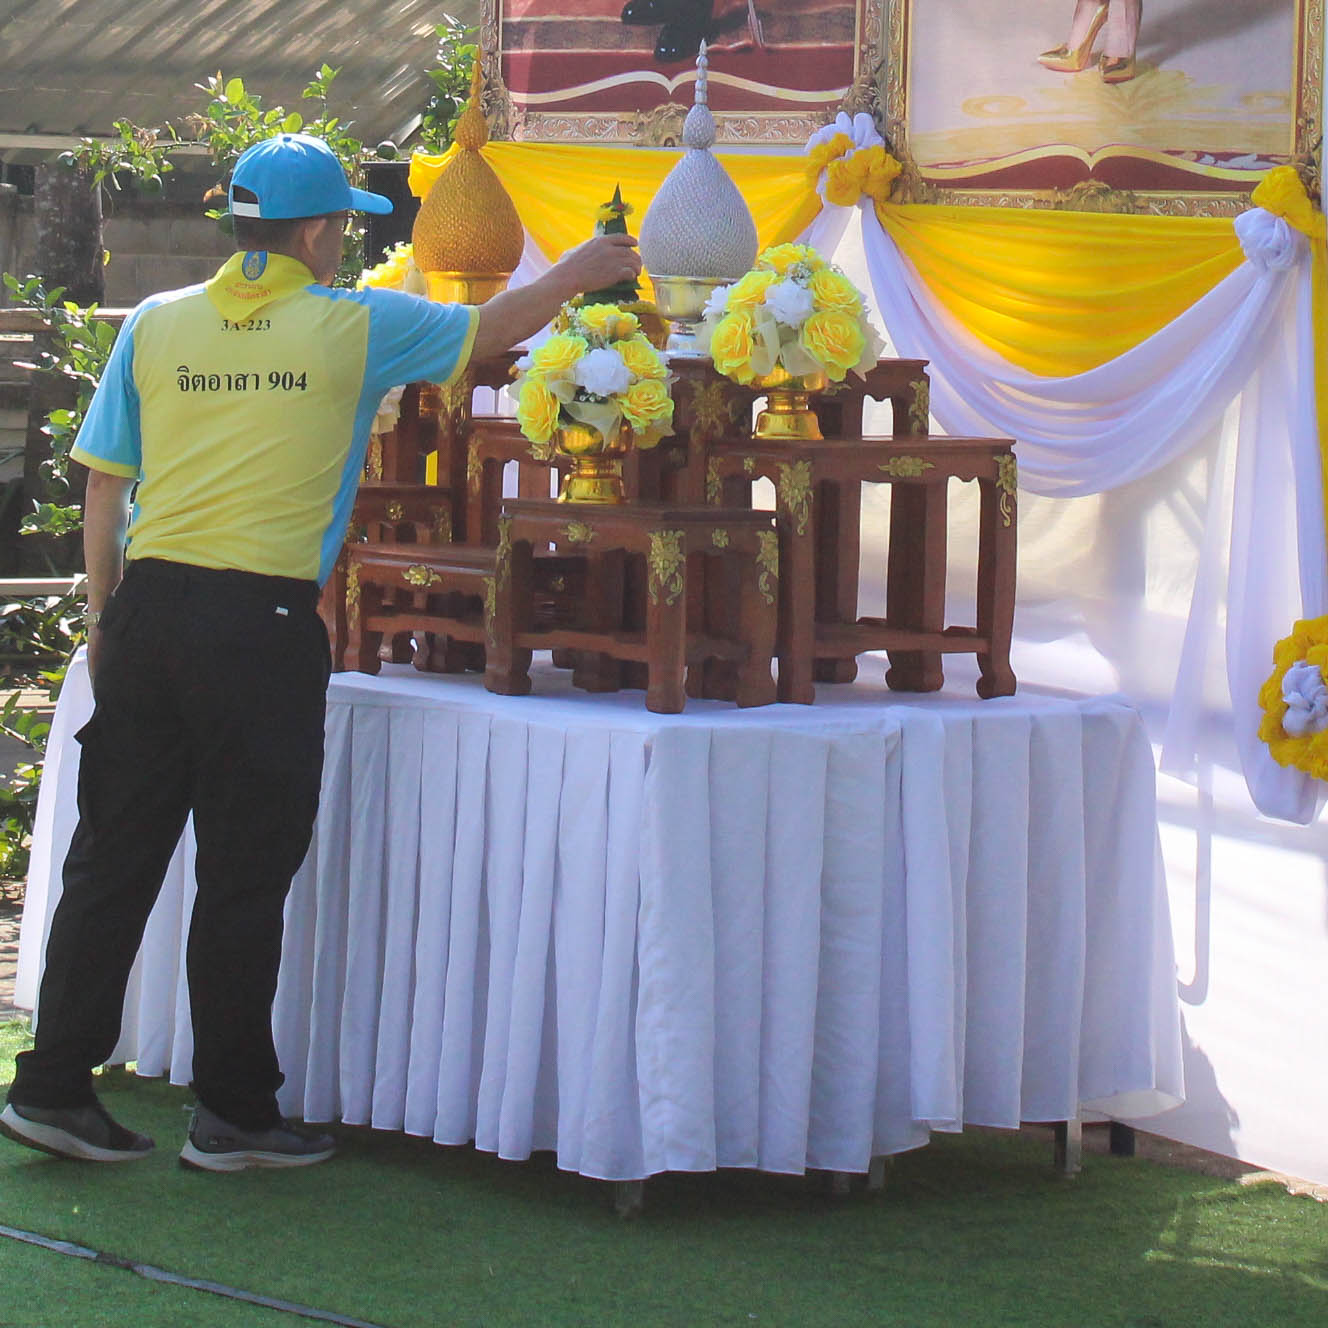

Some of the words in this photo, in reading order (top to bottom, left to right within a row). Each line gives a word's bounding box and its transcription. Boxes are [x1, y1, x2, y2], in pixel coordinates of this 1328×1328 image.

[177, 365, 260, 392] จิตอาสา
[268, 371, 308, 392] 904
